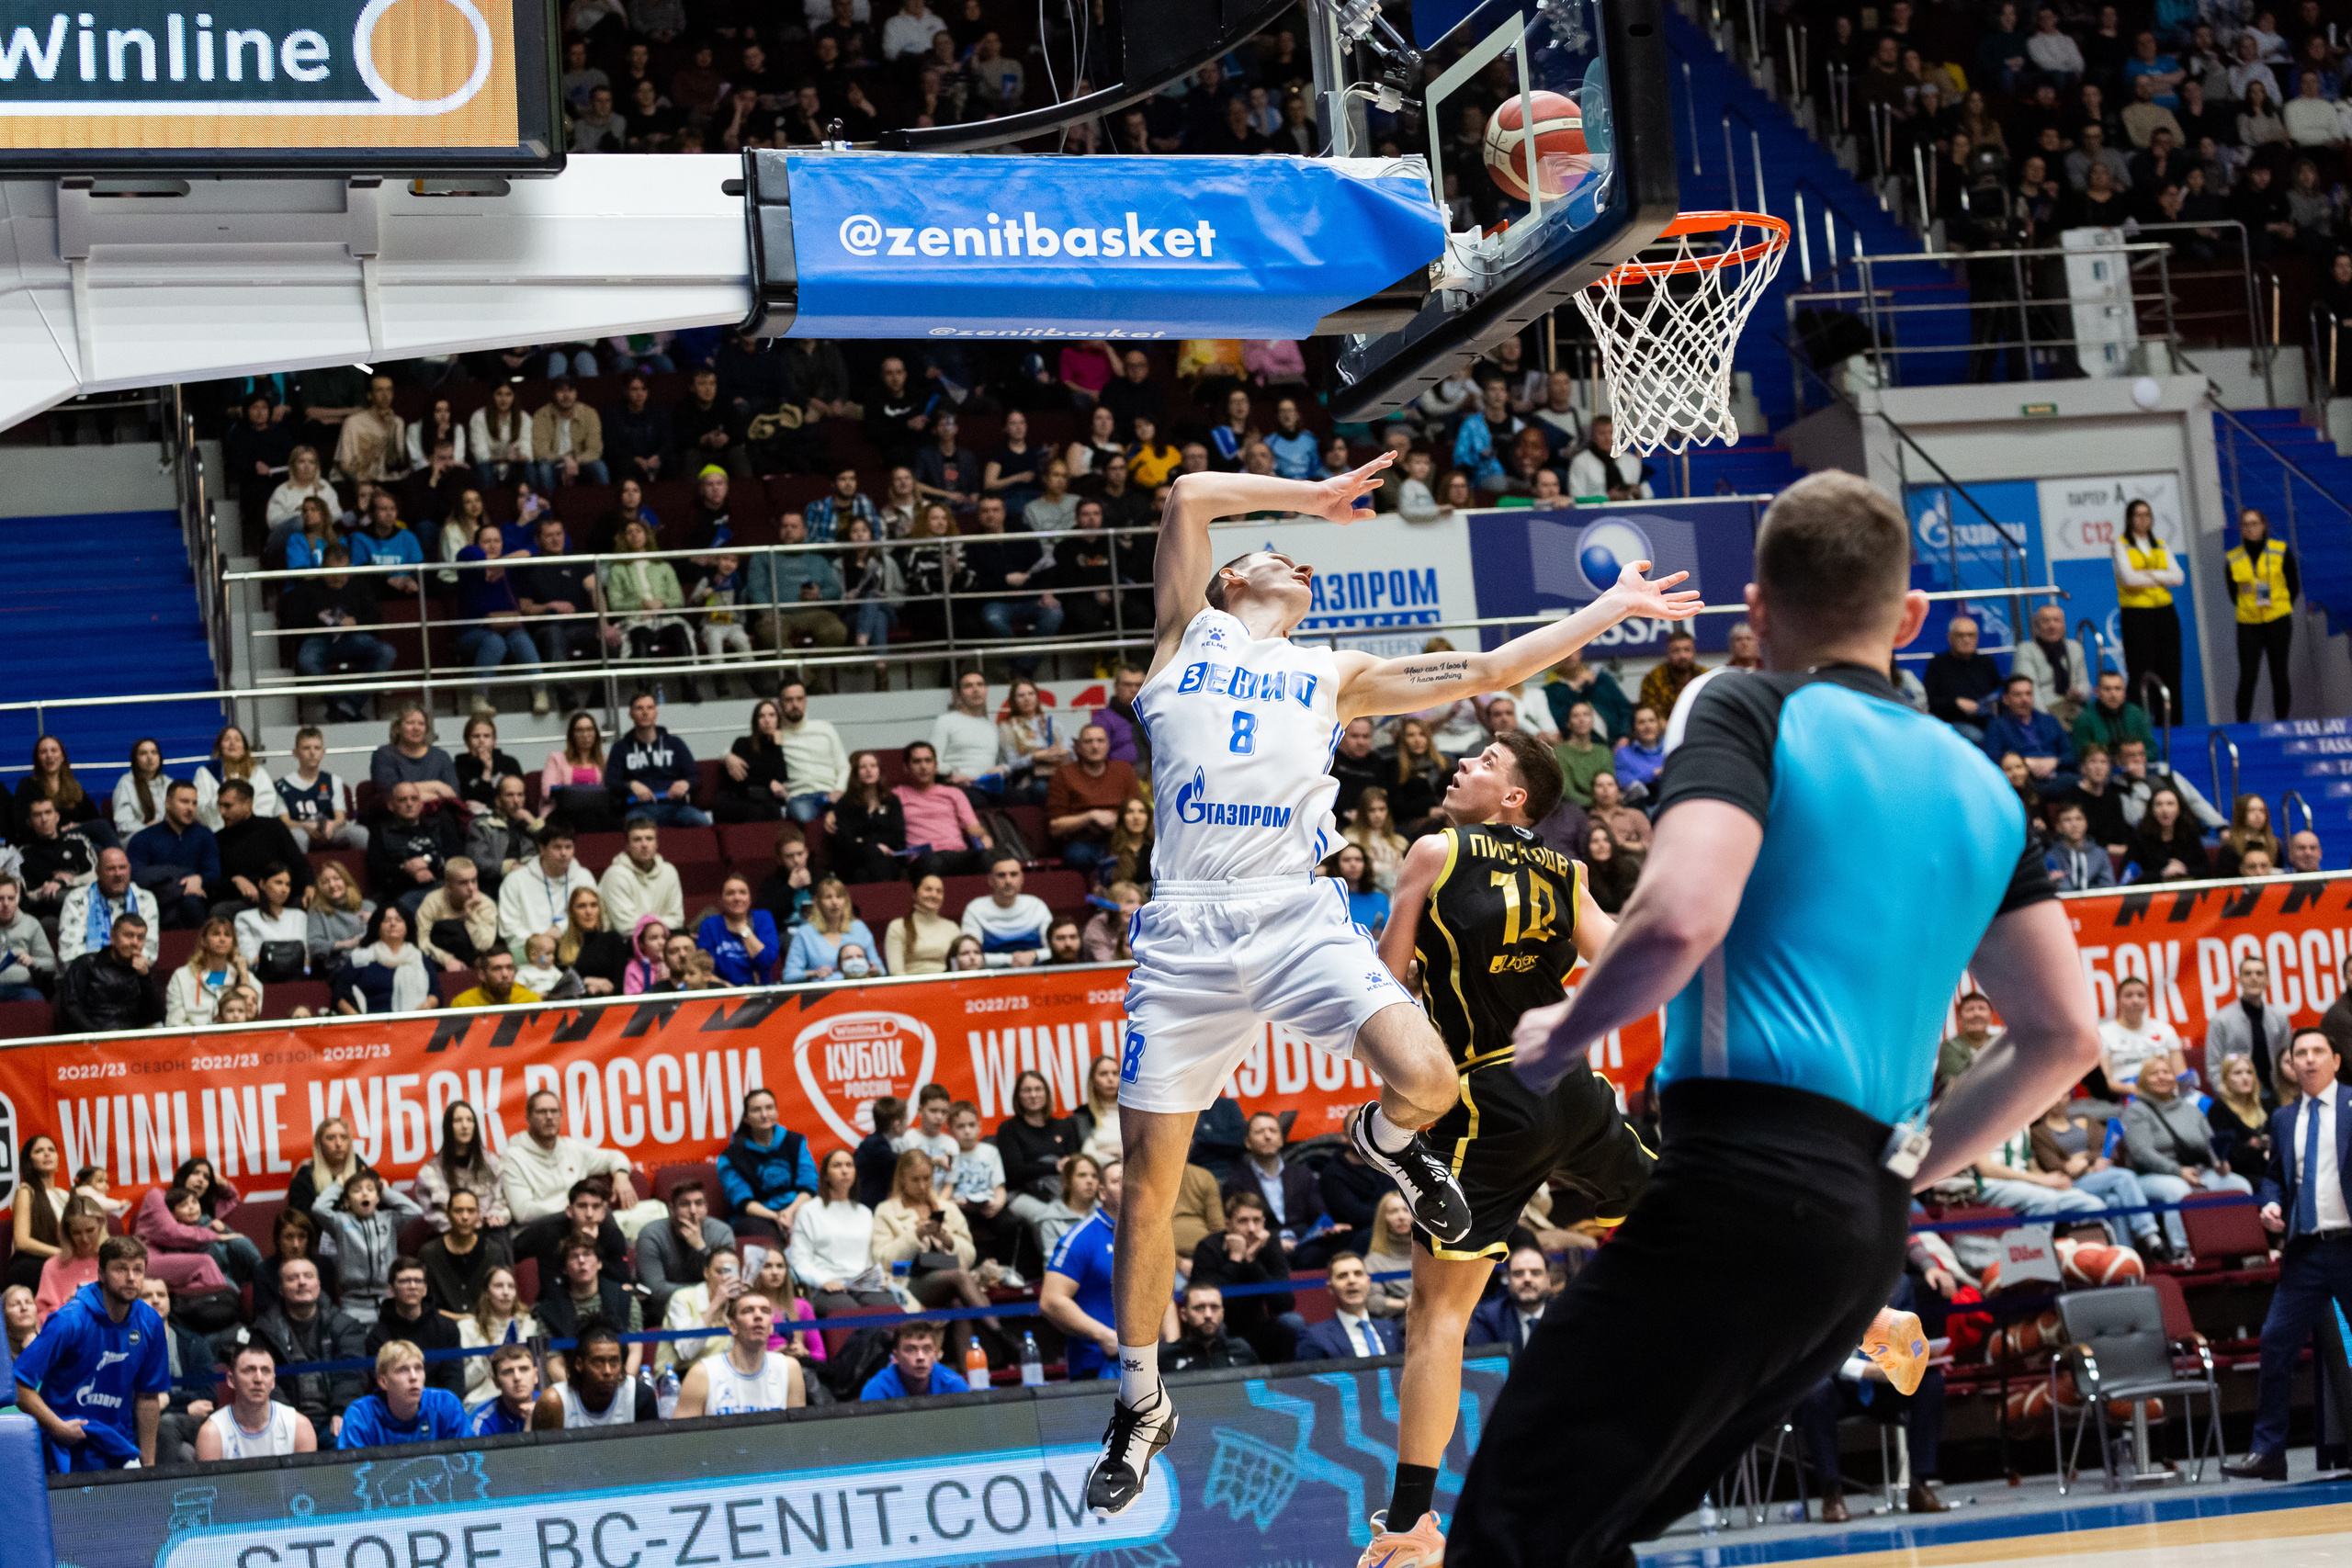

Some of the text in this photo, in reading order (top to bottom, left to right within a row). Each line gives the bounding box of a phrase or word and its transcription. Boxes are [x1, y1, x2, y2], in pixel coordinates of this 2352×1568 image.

[0, 13, 331, 82] Winline
[839, 211, 1216, 257] @zenitbasket
[928, 327, 1166, 339] @zenitbasket
[1309, 567, 1440, 613] АЗПРОМ
[1177, 661, 1317, 711] ЗЕНИТ
[1229, 710, 1258, 756] 8
[1206, 803, 1291, 829] ГАЗПРОМ
[966, 996, 1029, 1014] 2022/23
[1088, 988, 1127, 1005] 2022
[57, 1062, 127, 1081] 2022/23
[191, 1053, 260, 1072] 2022/23
[322, 1043, 391, 1062] 2022/23
[825, 1039, 906, 1082] КУБОК
[1120, 1031, 1147, 1085] 8
[844, 1079, 893, 1100] РОССИИ
[536, 1468, 1110, 1568] BC-ZENIT.COM
